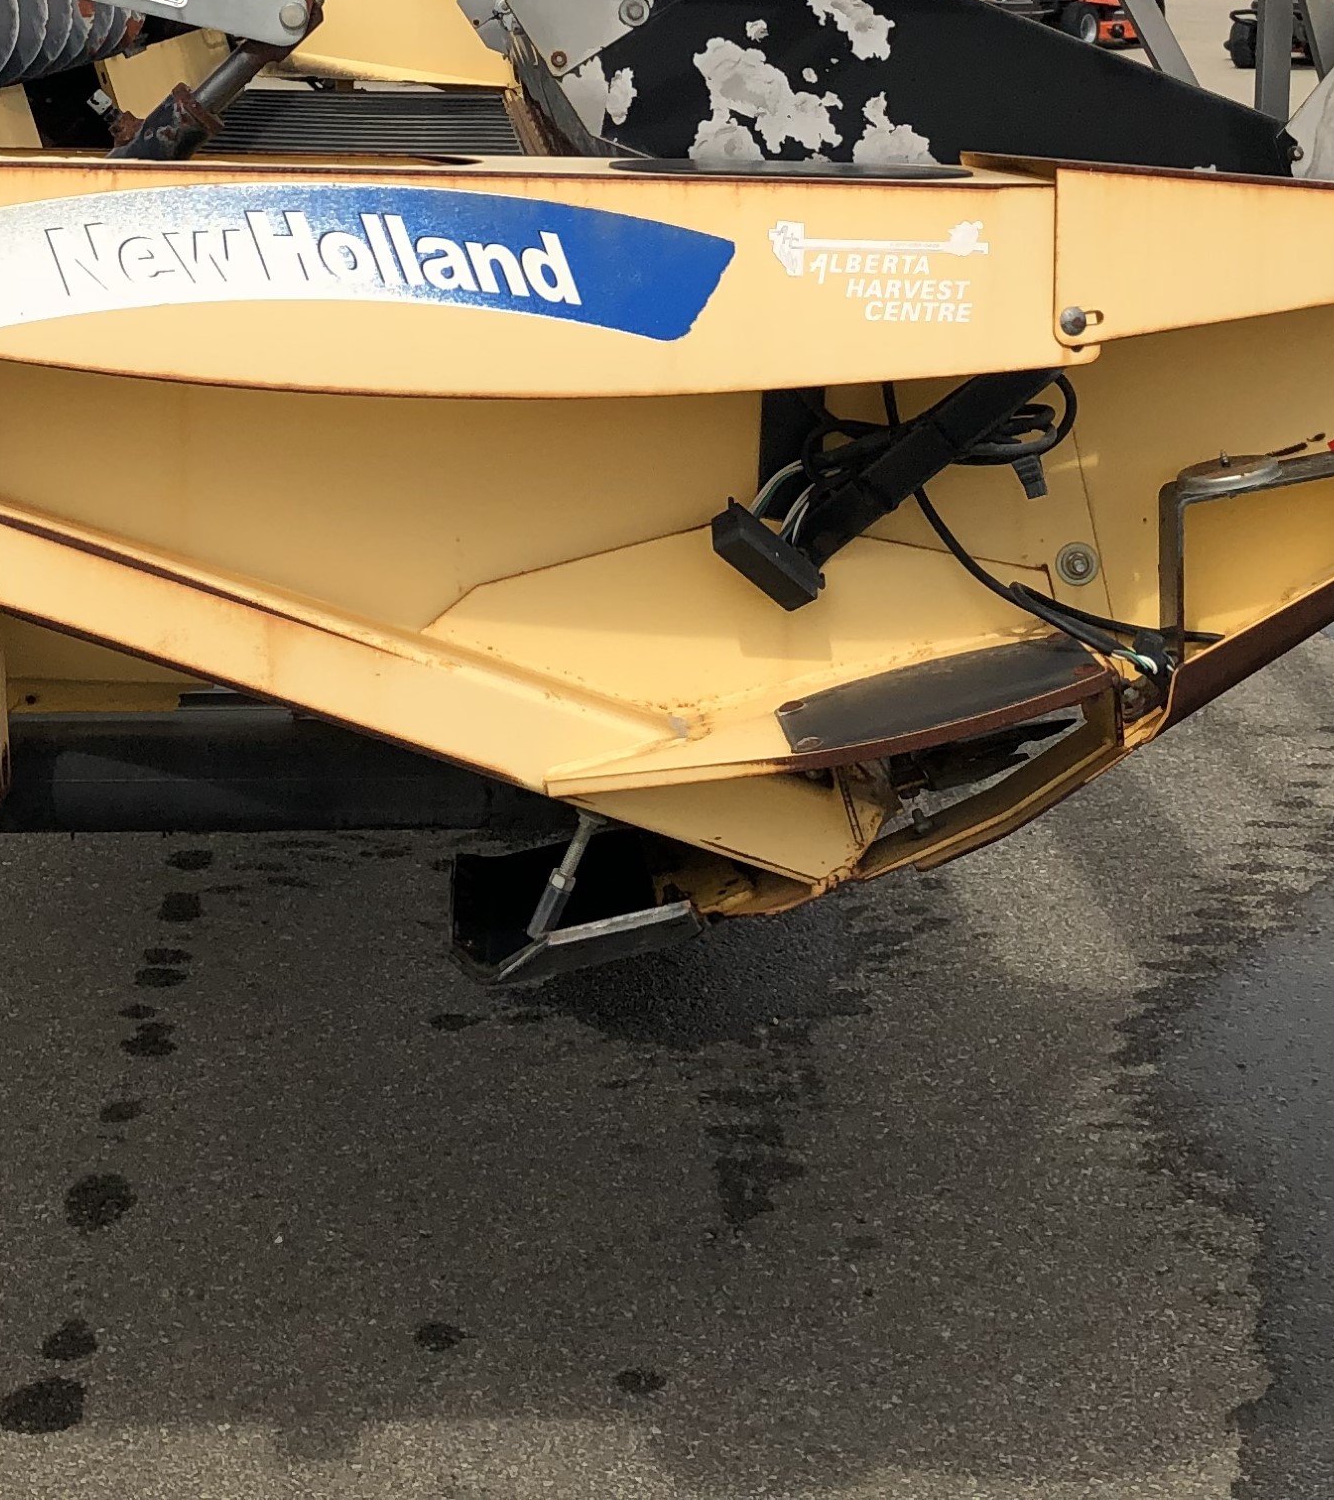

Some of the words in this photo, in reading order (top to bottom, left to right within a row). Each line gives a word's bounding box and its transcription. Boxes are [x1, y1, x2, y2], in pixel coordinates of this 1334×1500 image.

[810, 254, 930, 284] ALBERTA
[846, 278, 970, 300] HARVEST
[864, 300, 972, 323] CENTRE
